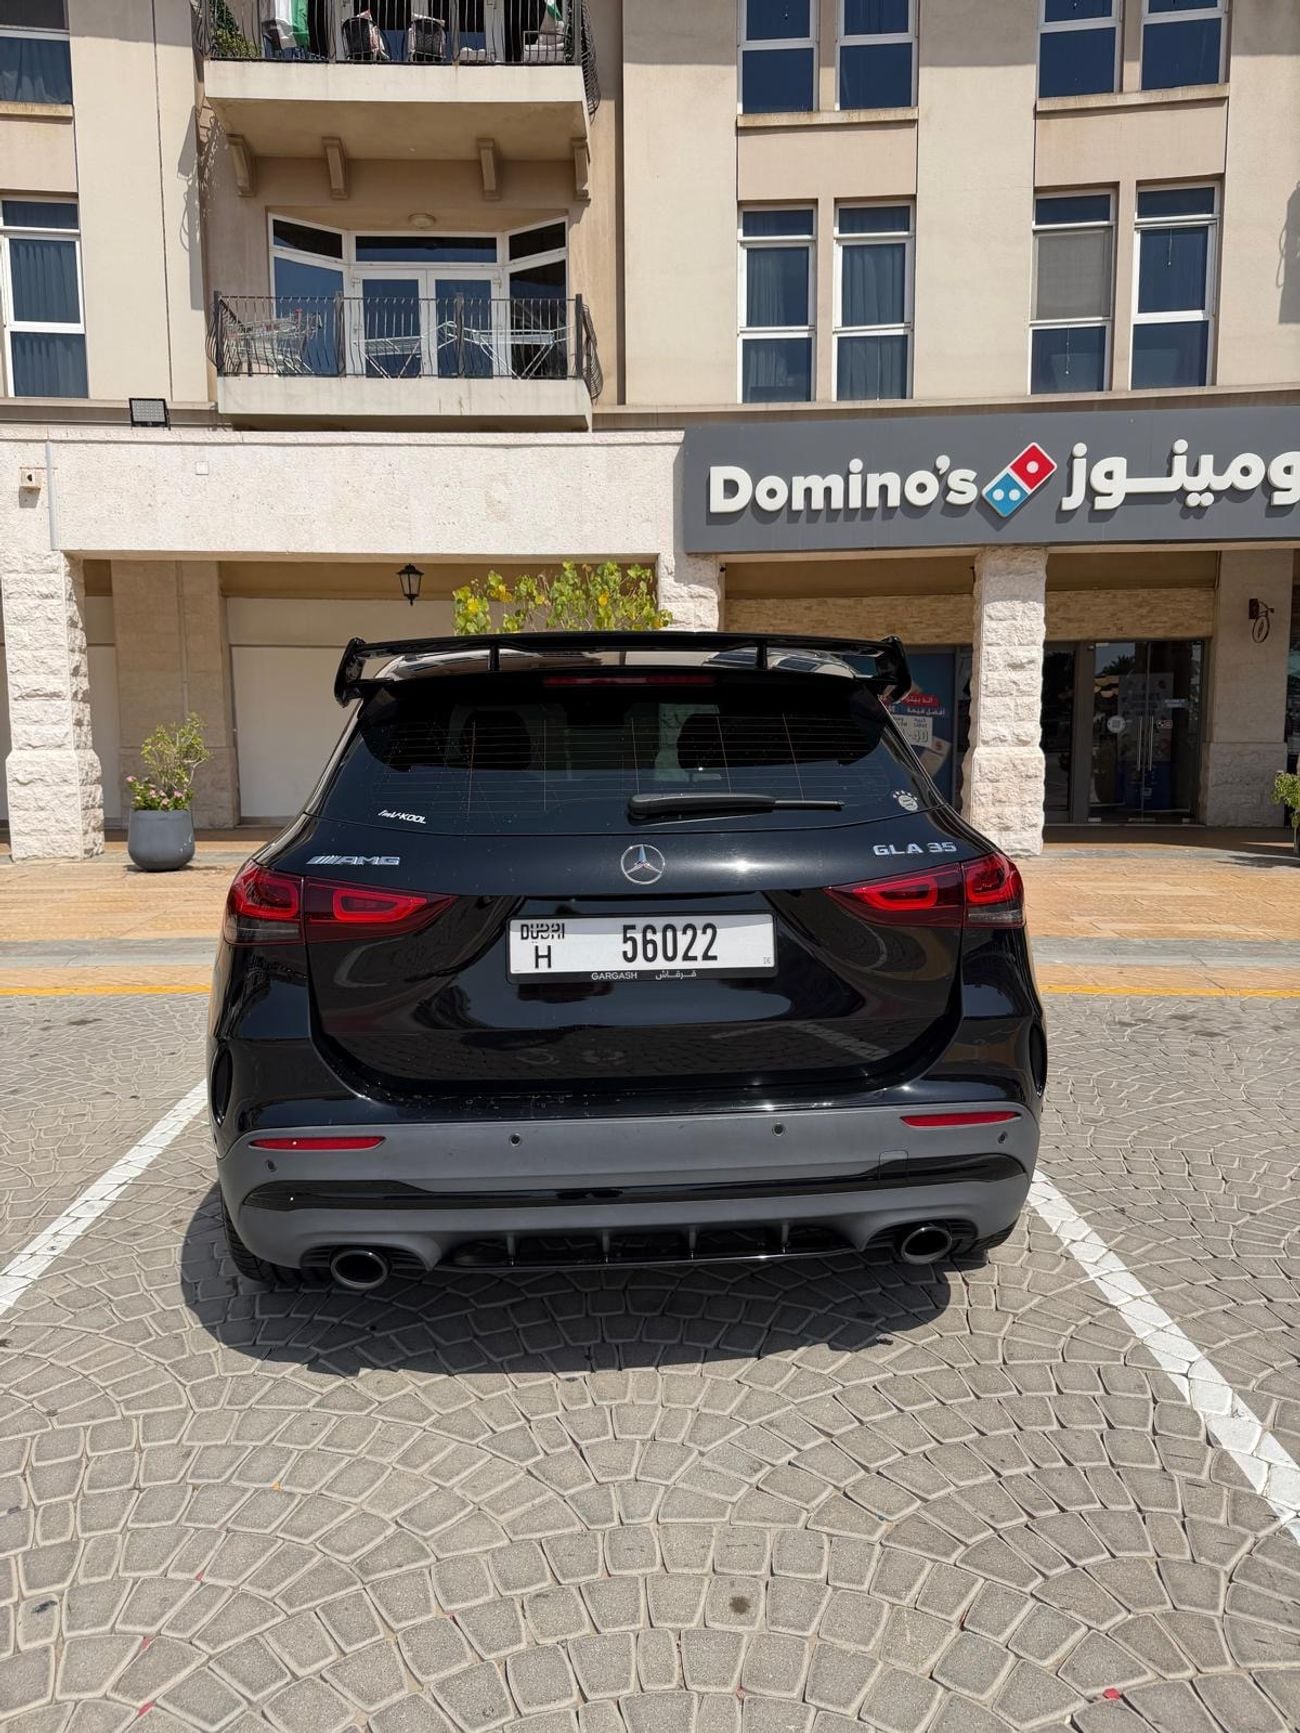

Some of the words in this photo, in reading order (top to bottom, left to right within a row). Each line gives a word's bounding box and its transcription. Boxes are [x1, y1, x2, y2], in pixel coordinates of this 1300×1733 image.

[709, 455, 978, 513] Domino's
[1060, 438, 1300, 511] ومينوز
[872, 843, 924, 856] GLA
[926, 841, 957, 854] 35
[520, 922, 565, 940] DUBAI
[622, 922, 719, 963] 56022
[534, 945, 552, 969] H
[591, 971, 639, 981] GARGASH
